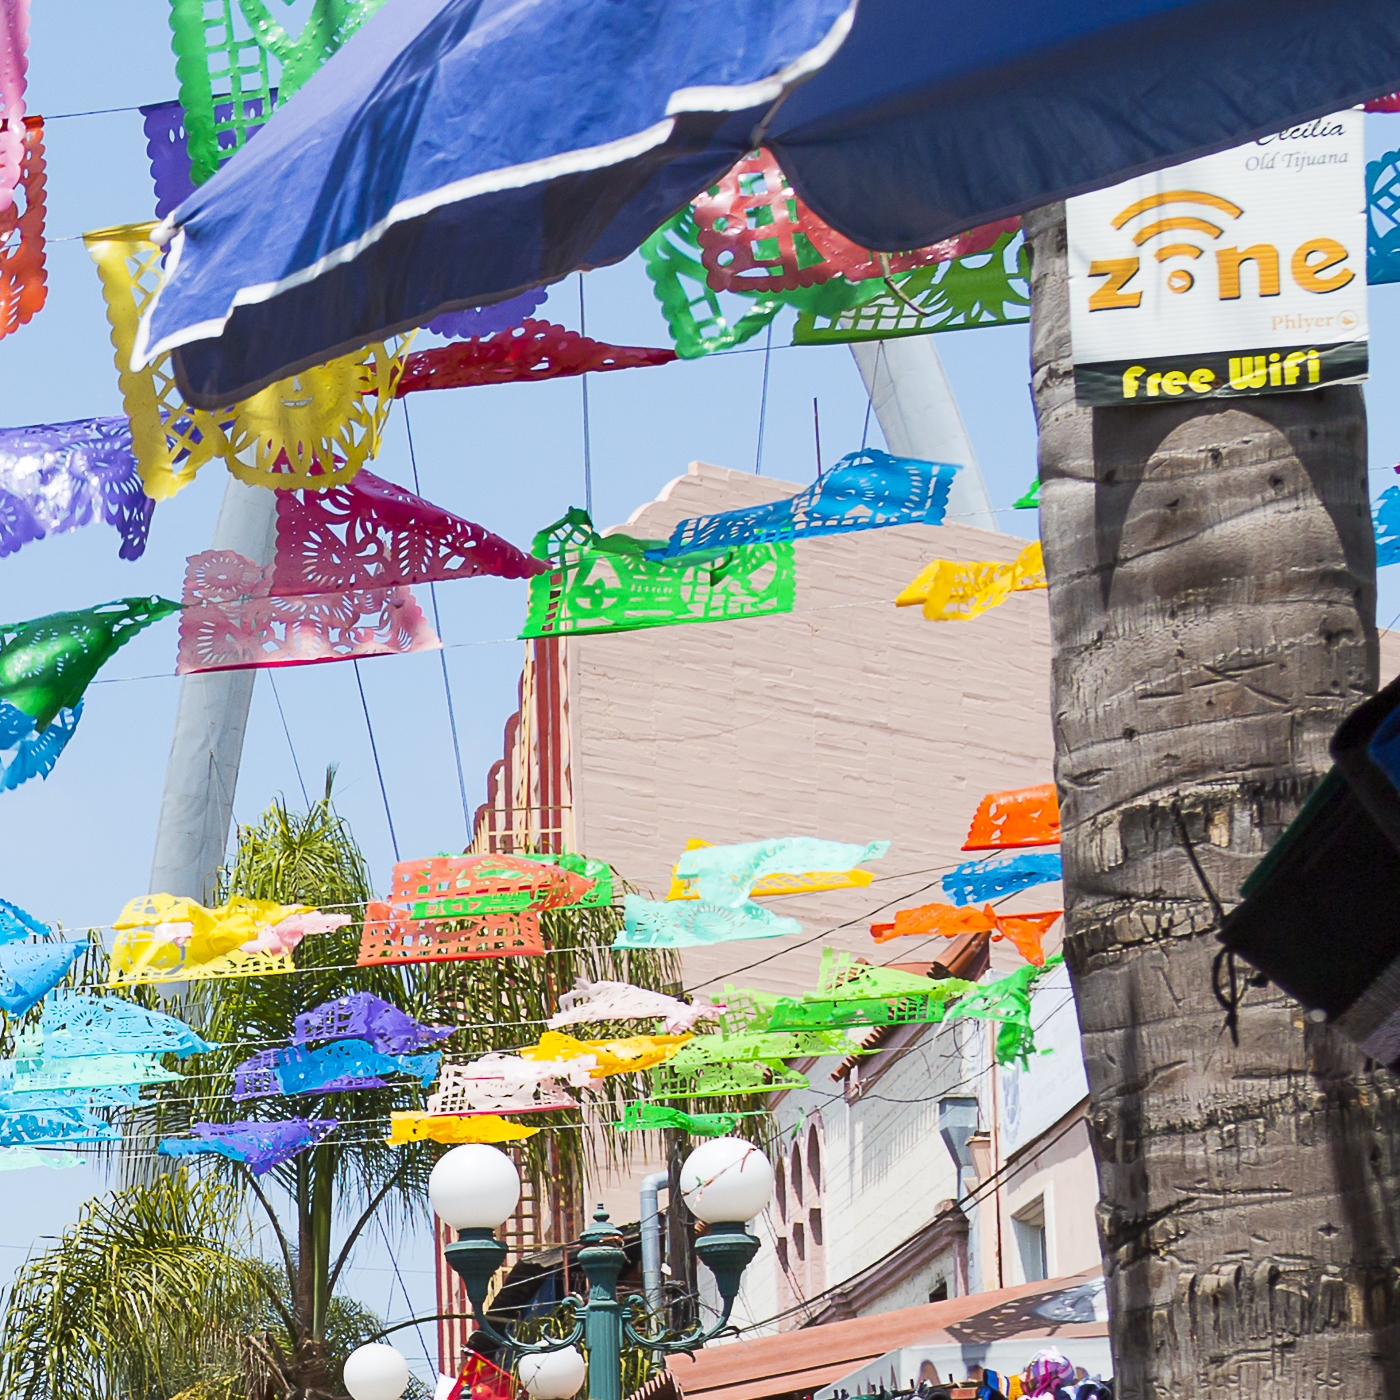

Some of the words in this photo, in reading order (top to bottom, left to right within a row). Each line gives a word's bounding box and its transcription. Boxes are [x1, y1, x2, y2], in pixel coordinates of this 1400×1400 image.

[1245, 151, 1281, 172] Old
[1282, 151, 1349, 173] Tijuana
[1271, 312, 1336, 333] Phlyer
